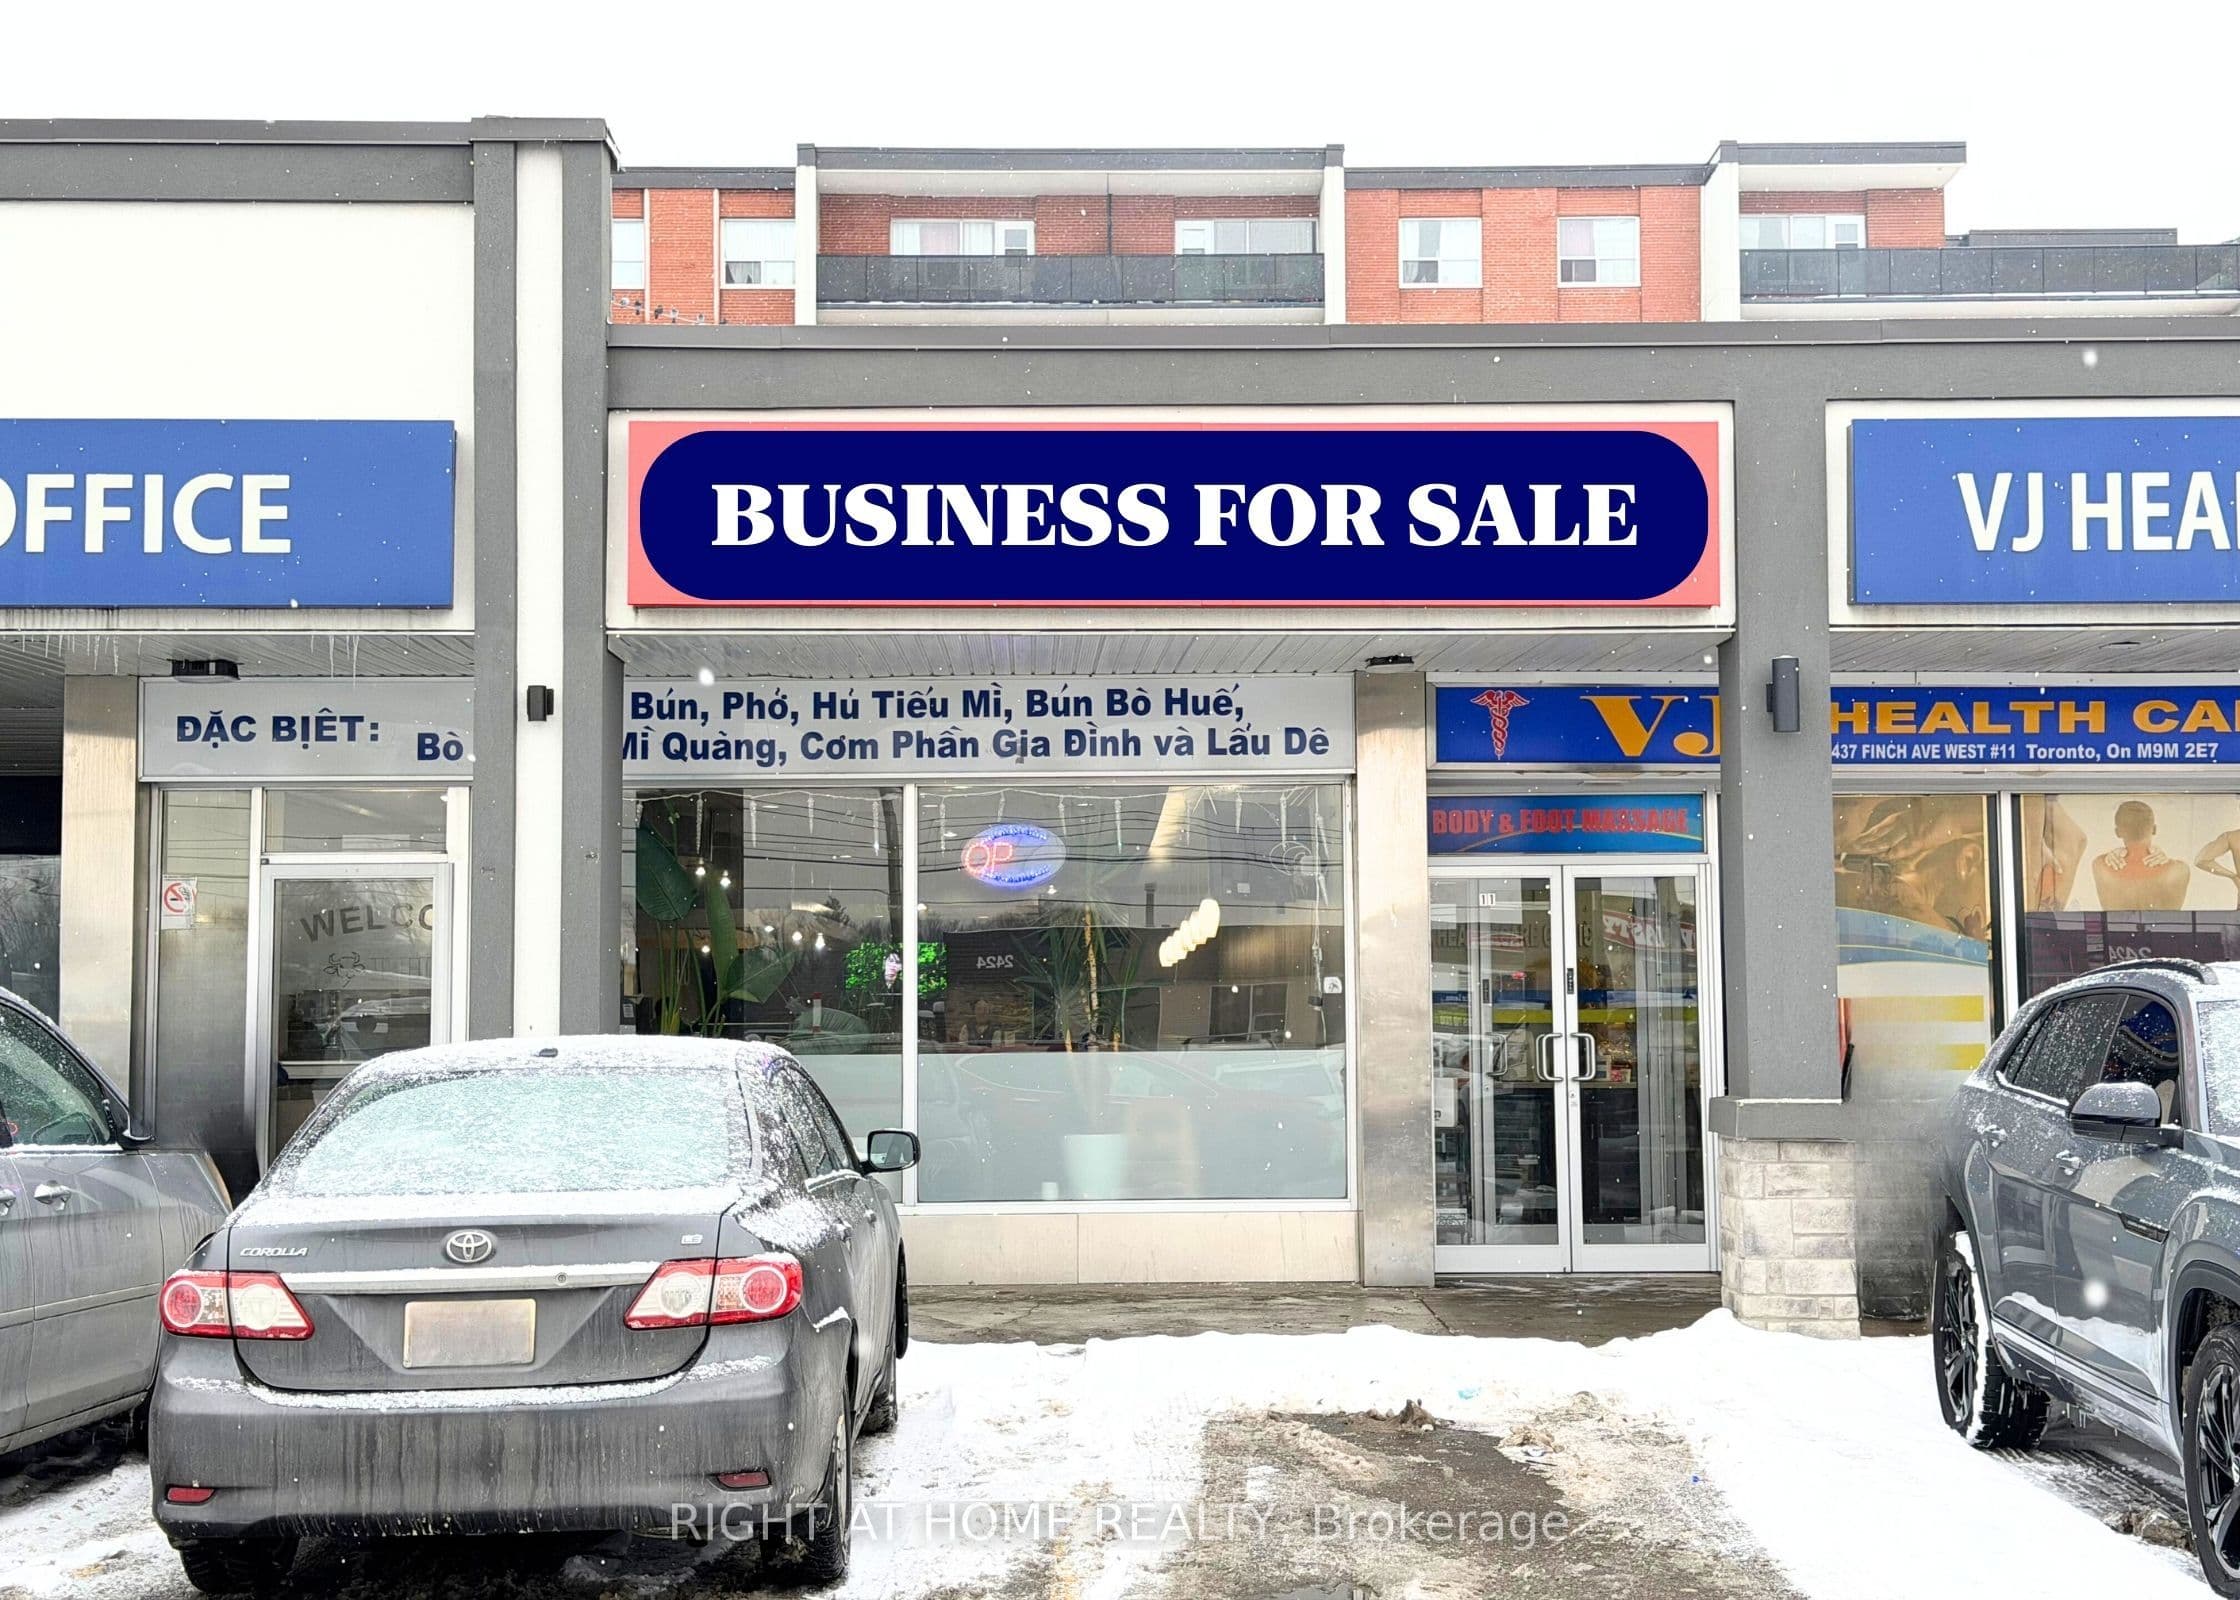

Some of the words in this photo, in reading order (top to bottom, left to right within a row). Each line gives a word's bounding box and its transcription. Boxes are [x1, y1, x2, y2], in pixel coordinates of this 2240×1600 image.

[0, 473, 291, 554] FFICE
[1957, 472, 2044, 552] VJ
[2071, 471, 2240, 551] HEA
[631, 687, 709, 727] Bún,
[962, 682, 1012, 724] Mì,
[1026, 683, 1092, 718] Bún
[1106, 686, 1152, 717] Bò
[1164, 682, 1243, 722] Huế,
[1830, 701, 2105, 734] HEALTH
[2132, 700, 2240, 734] CA
[176, 709, 257, 749] ĐẶC
[417, 731, 464, 761] Bò
[800, 731, 879, 760] Cơm
[992, 729, 1050, 758] Gia
[1064, 721, 1141, 757] Đình
[1154, 726, 1194, 756] và
[1284, 727, 1329, 755] Dê
[1862, 743, 1907, 759] FINCH
[1911, 743, 1942, 759] AVE
[1944, 743, 1986, 759] WEST
[1990, 743, 2015, 759] #11
[2026, 743, 2101, 762] Toronto,
[2106, 743, 2131, 759] On
[2137, 742, 2180, 758] M9M
[2185, 742, 2219, 758] 2E7
[1432, 809, 1494, 834] BODY
[1499, 814, 1515, 834] &
[1520, 809, 1576, 833] FOOT
[1582, 808, 1689, 833] MASSAGE
[240, 1247, 308, 1257] COROLLA
